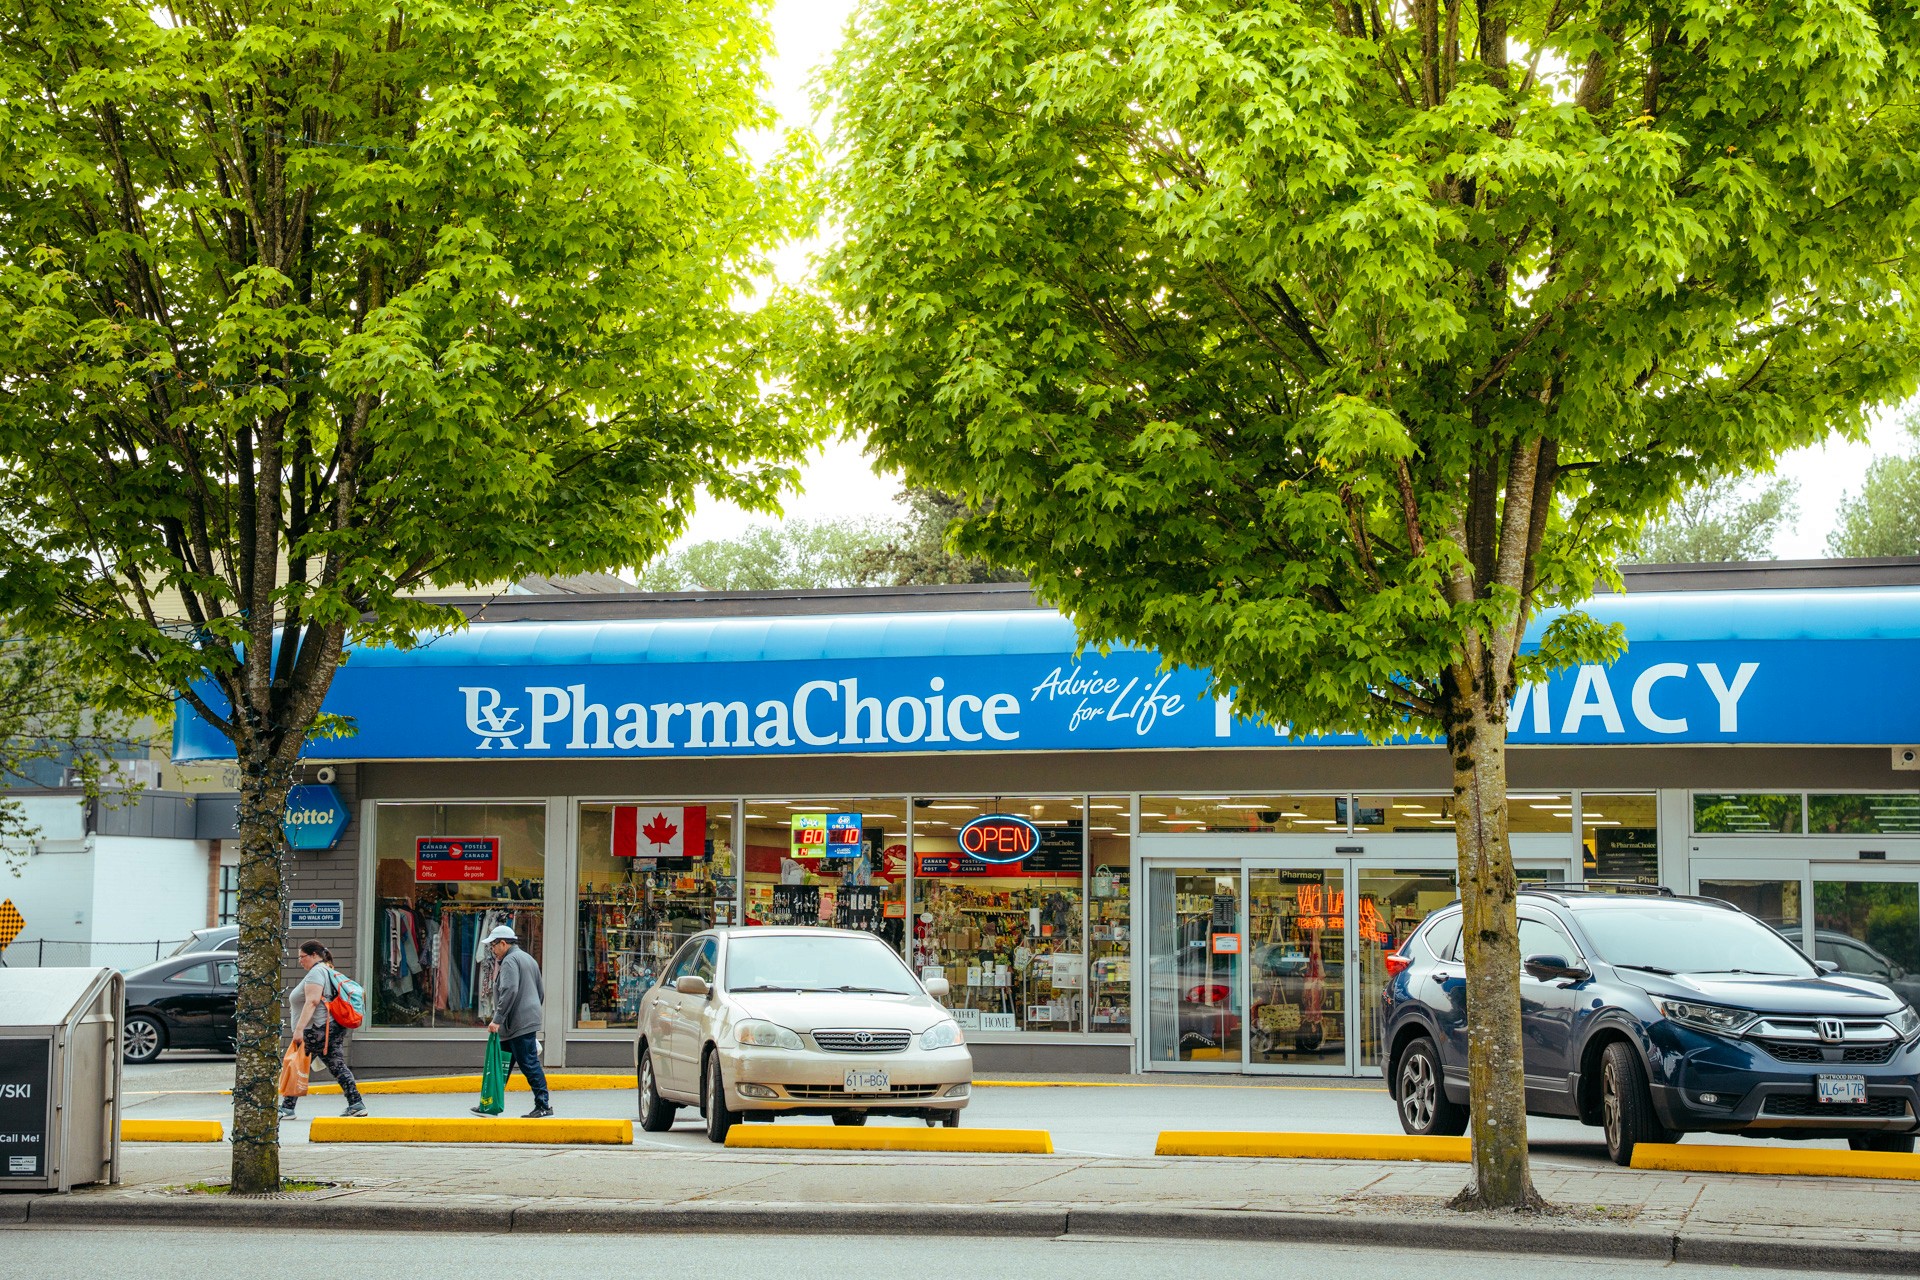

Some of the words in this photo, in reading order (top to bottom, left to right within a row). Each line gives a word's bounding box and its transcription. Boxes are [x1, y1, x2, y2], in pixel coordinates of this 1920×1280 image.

[1031, 666, 1120, 701] Advice
[1068, 698, 1105, 732] for
[1106, 673, 1185, 736] Life
[523, 676, 1021, 750] PharmaChoice
[285, 808, 334, 825] lotto!
[803, 829, 824, 844] 80
[844, 828, 860, 843] 10
[963, 826, 1030, 852] OPEN
[1628, 831, 1635, 840] 2
[1281, 870, 1322, 880] Pharmacy
[984, 1017, 1012, 1028] HOME
[0, 1134, 18, 1142] Call
[21, 1134, 40, 1142] Me!
